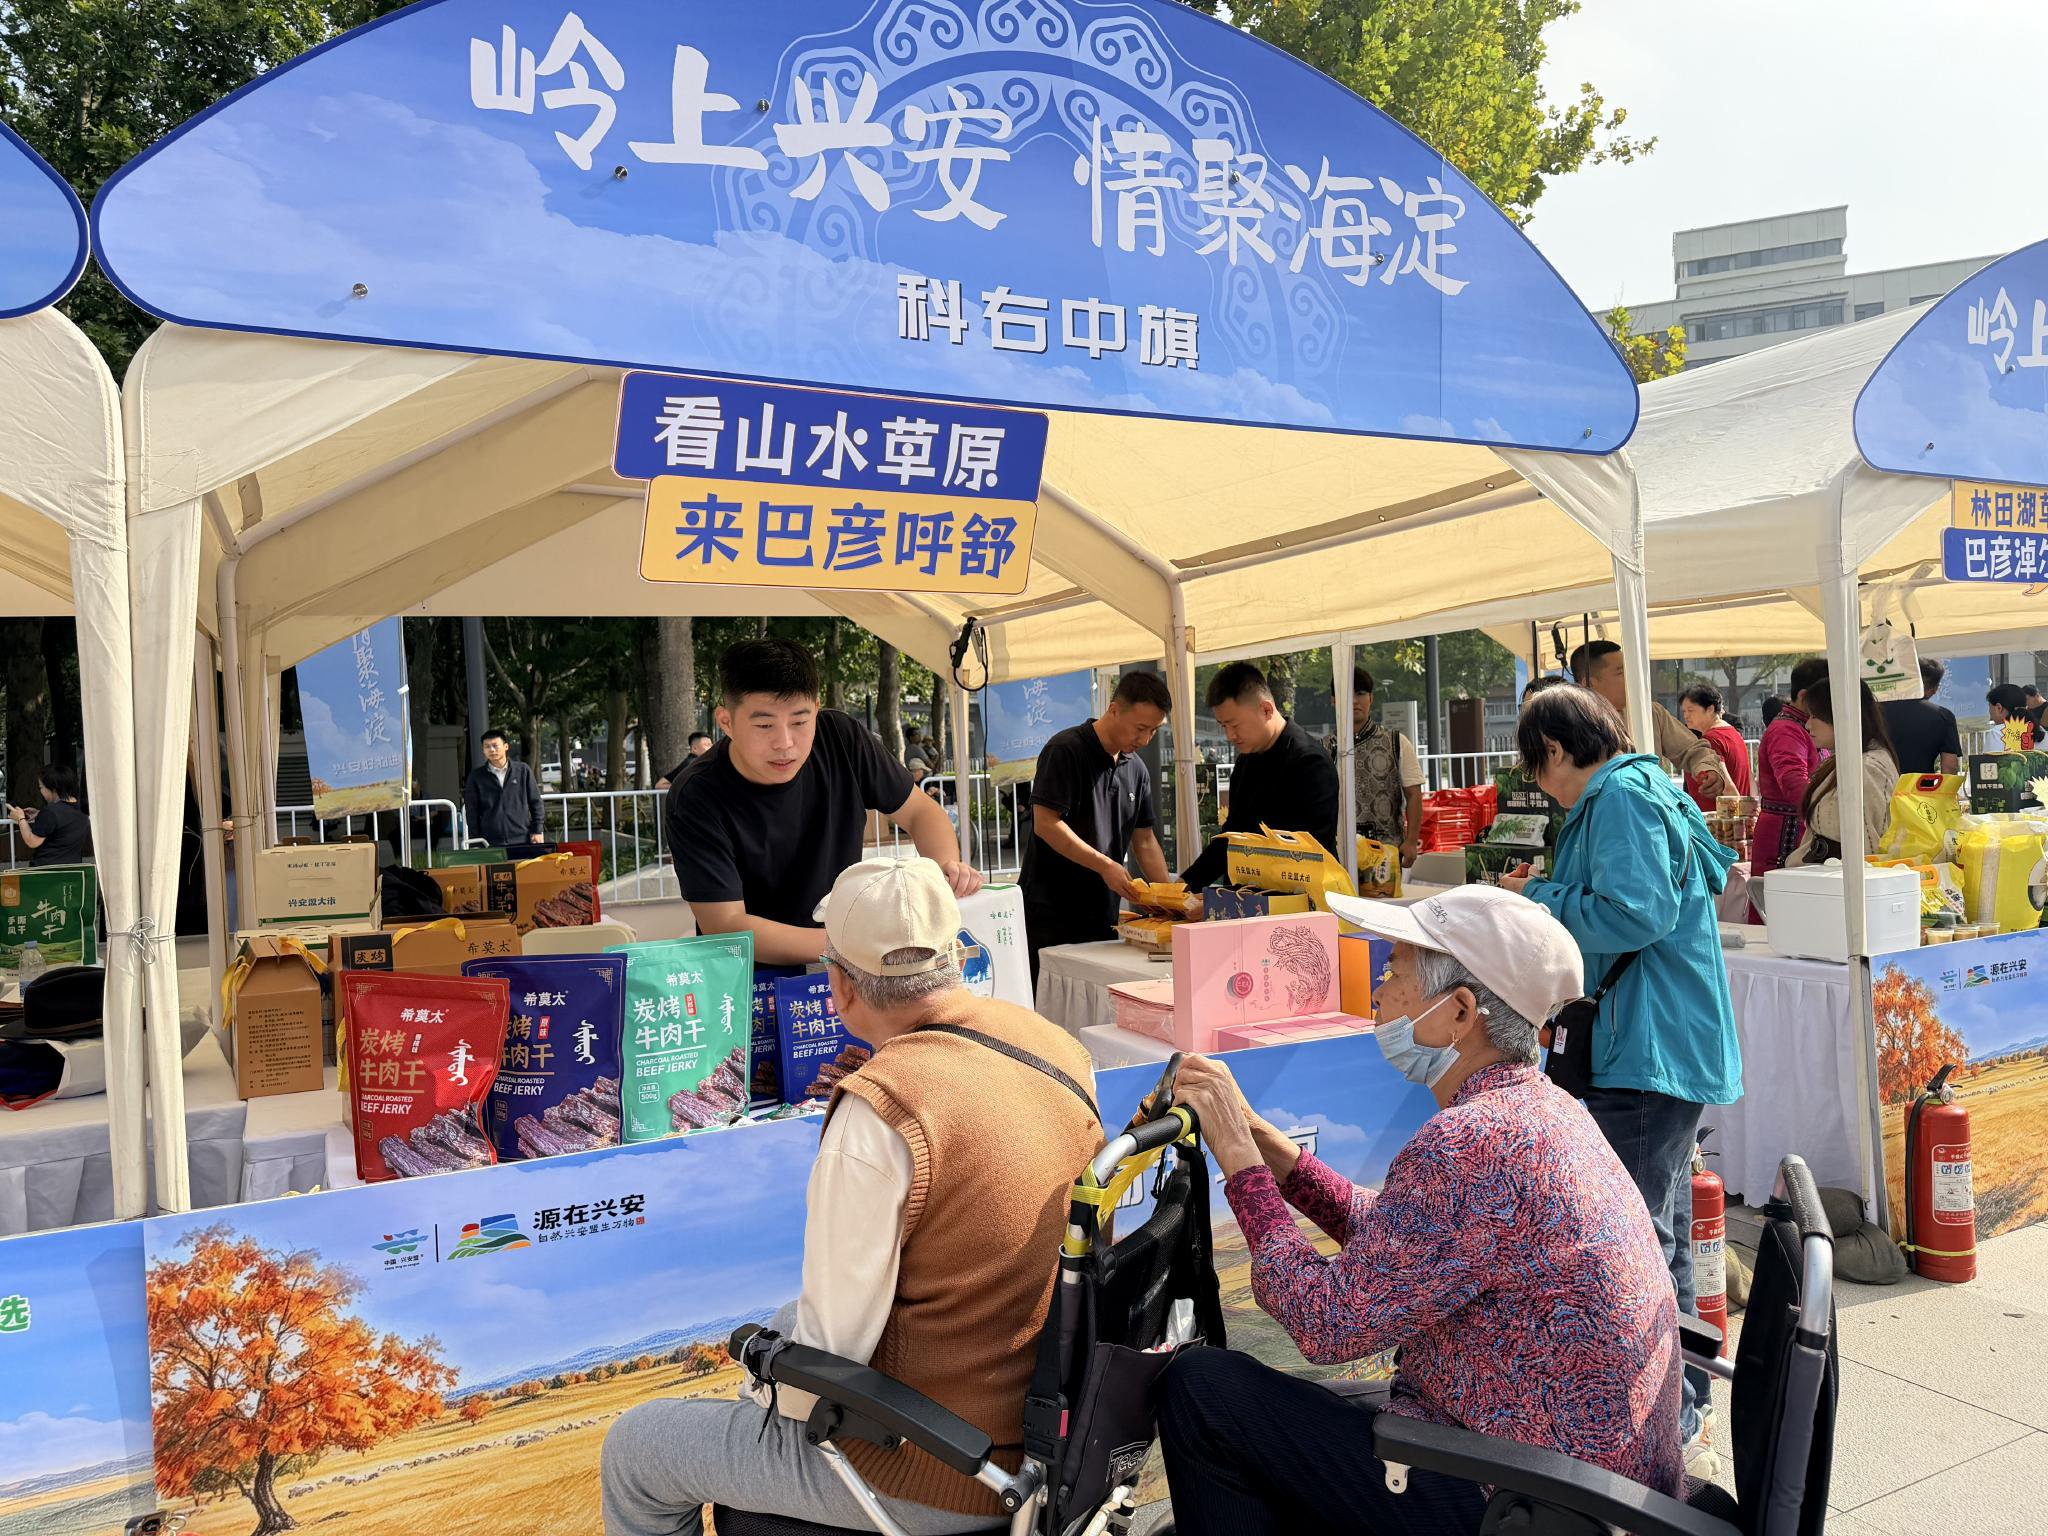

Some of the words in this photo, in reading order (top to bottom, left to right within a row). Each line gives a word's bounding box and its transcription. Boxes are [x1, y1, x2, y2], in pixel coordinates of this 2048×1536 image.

[471, 12, 1010, 230] 岭上兴安
[1074, 115, 1469, 296] 情聚海淀
[898, 274, 1199, 369] 科右中旗
[654, 396, 1006, 491] 看山水草原
[675, 493, 1018, 579] 来巴彦呼舒
[524, 991, 567, 1007] 希莫太
[633, 995, 681, 1024] 炭烤
[789, 999, 823, 1018] 炭烤
[400, 1007, 445, 1024] 希莫太
[635, 1018, 706, 1051] 牛肉干
[792, 1016, 841, 1038] 牛肉干
[360, 1027, 407, 1056] 炭烤
[793, 1049, 814, 1059] BEEF
[814, 1045, 838, 1056] JERKY
[636, 1056, 670, 1067] CHARCOAL
[671, 1051, 699, 1062] ROASTED
[636, 1064, 665, 1078] BEEF
[666, 1059, 699, 1073] JERKY
[360, 1058, 426, 1088] 牛肉干
[386, 1095, 413, 1103] ROASTED
[494, 1082, 512, 1095] BEEF
[513, 1085, 544, 1096] JERKY
[380, 1103, 412, 1115] JERKY
[533, 1193, 645, 1231] 源在兴安
